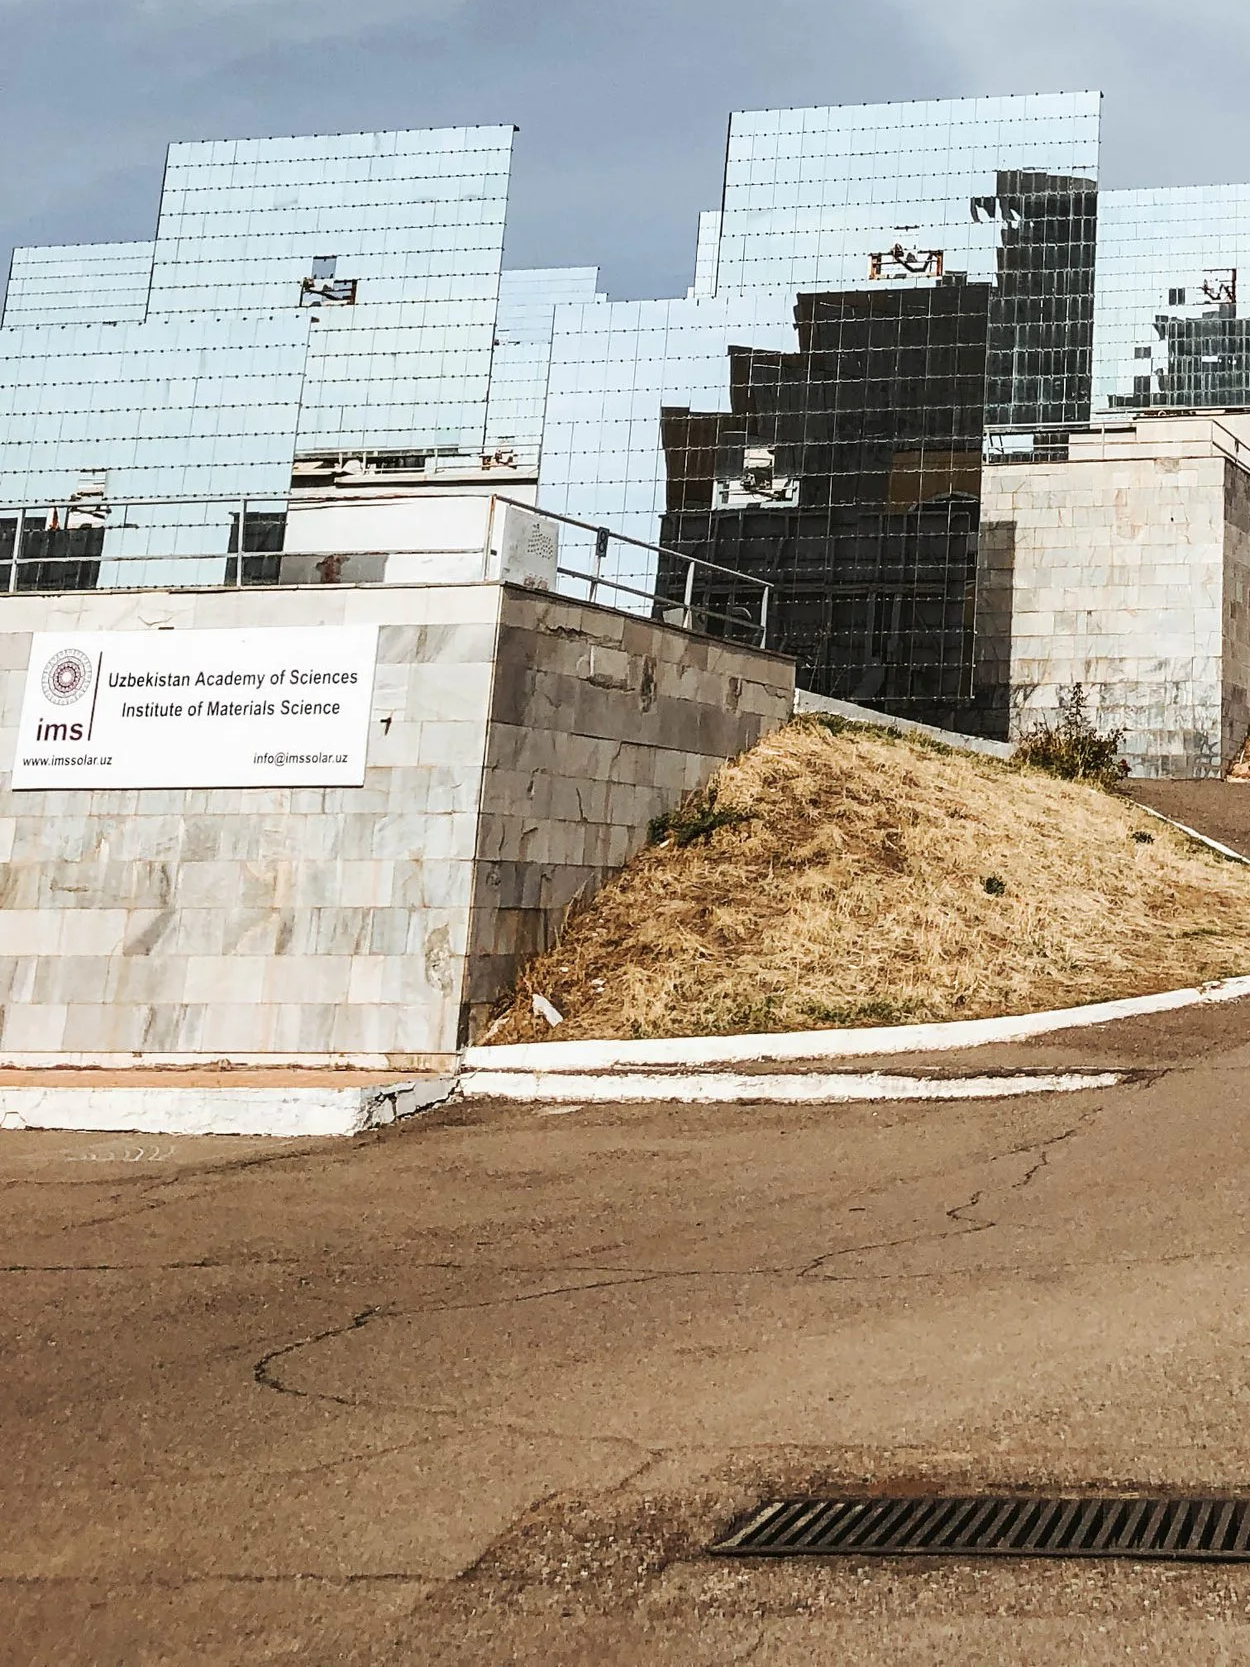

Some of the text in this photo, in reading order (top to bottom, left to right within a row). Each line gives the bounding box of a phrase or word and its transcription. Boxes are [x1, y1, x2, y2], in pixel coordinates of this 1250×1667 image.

[108, 669, 358, 690] Uzbekistan Academy of Sciences
[121, 699, 341, 718] Institute of Materials Science
[36, 717, 84, 742] ims
[22, 754, 113, 766] www.imssolar.uz
[253, 752, 348, 767] info@imssolar.uz
